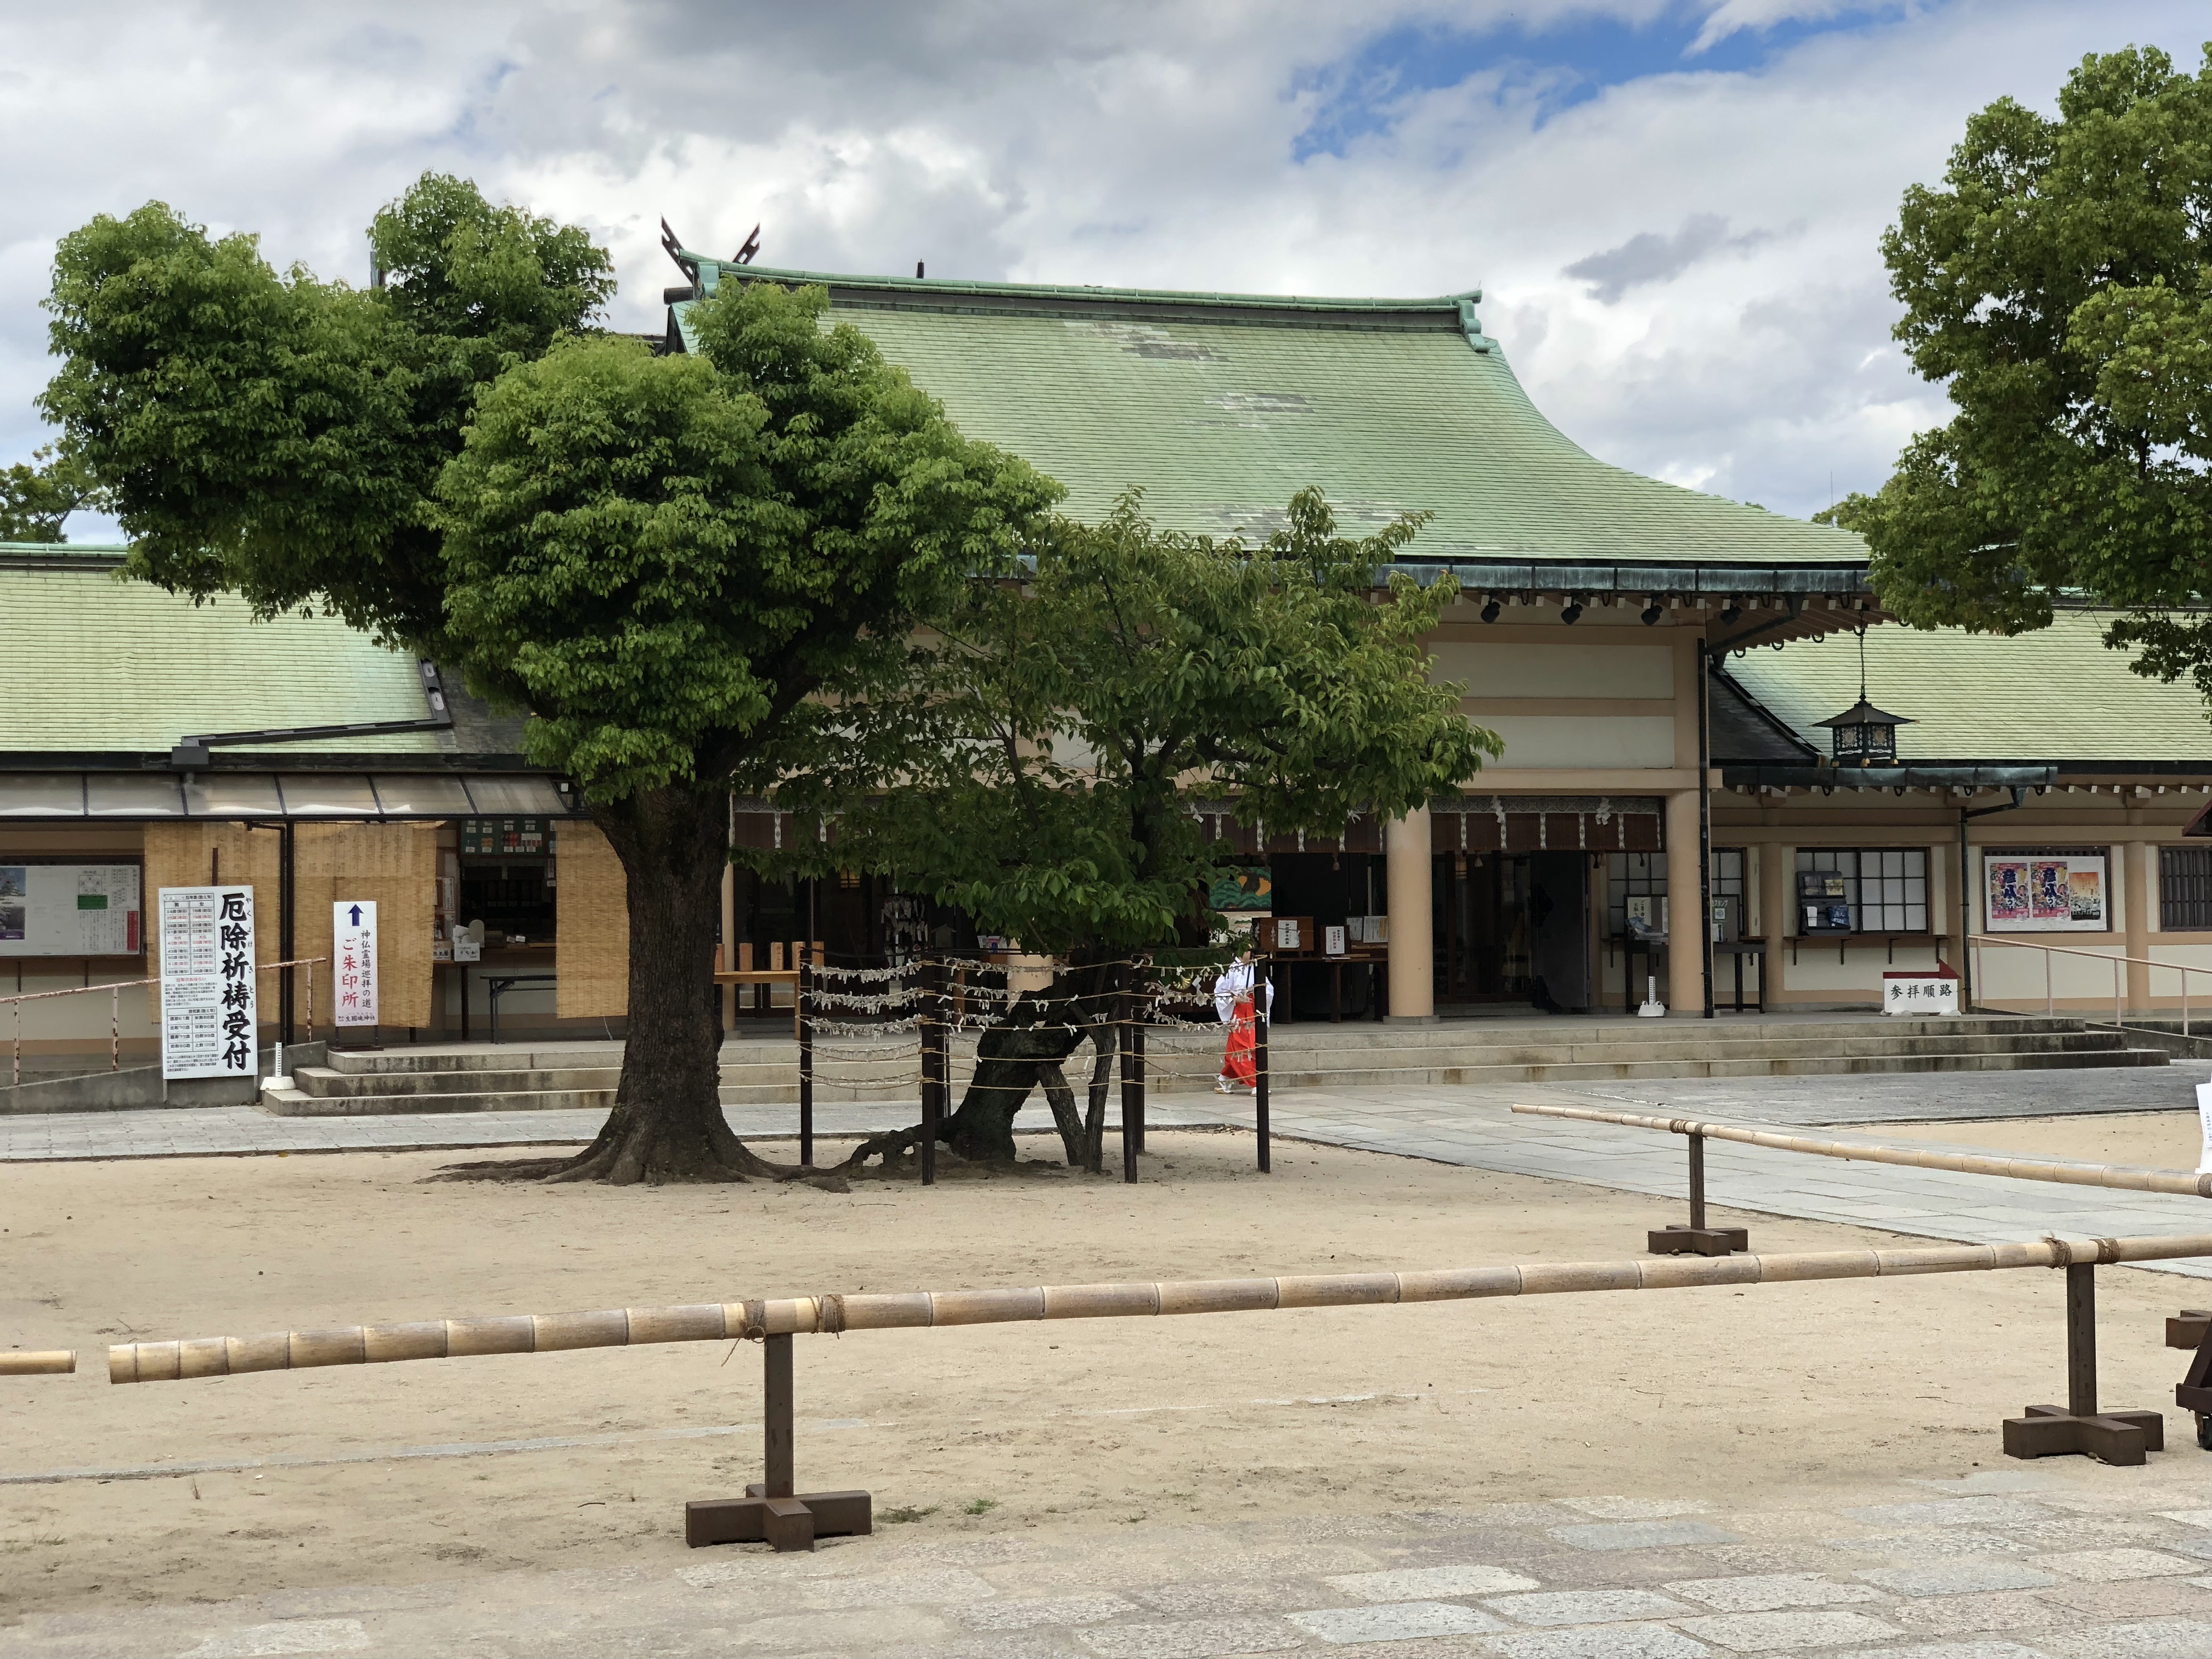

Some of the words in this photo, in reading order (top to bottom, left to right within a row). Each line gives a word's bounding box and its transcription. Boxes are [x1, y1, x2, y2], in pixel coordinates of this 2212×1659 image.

[219, 893, 251, 1070] 厄除祈祷受付
[342, 938, 359, 1008] ご朱印所
[360, 929, 372, 1008] 神仏霊場巡拝の道
[1891, 984, 1953, 1000] 参拝順路
